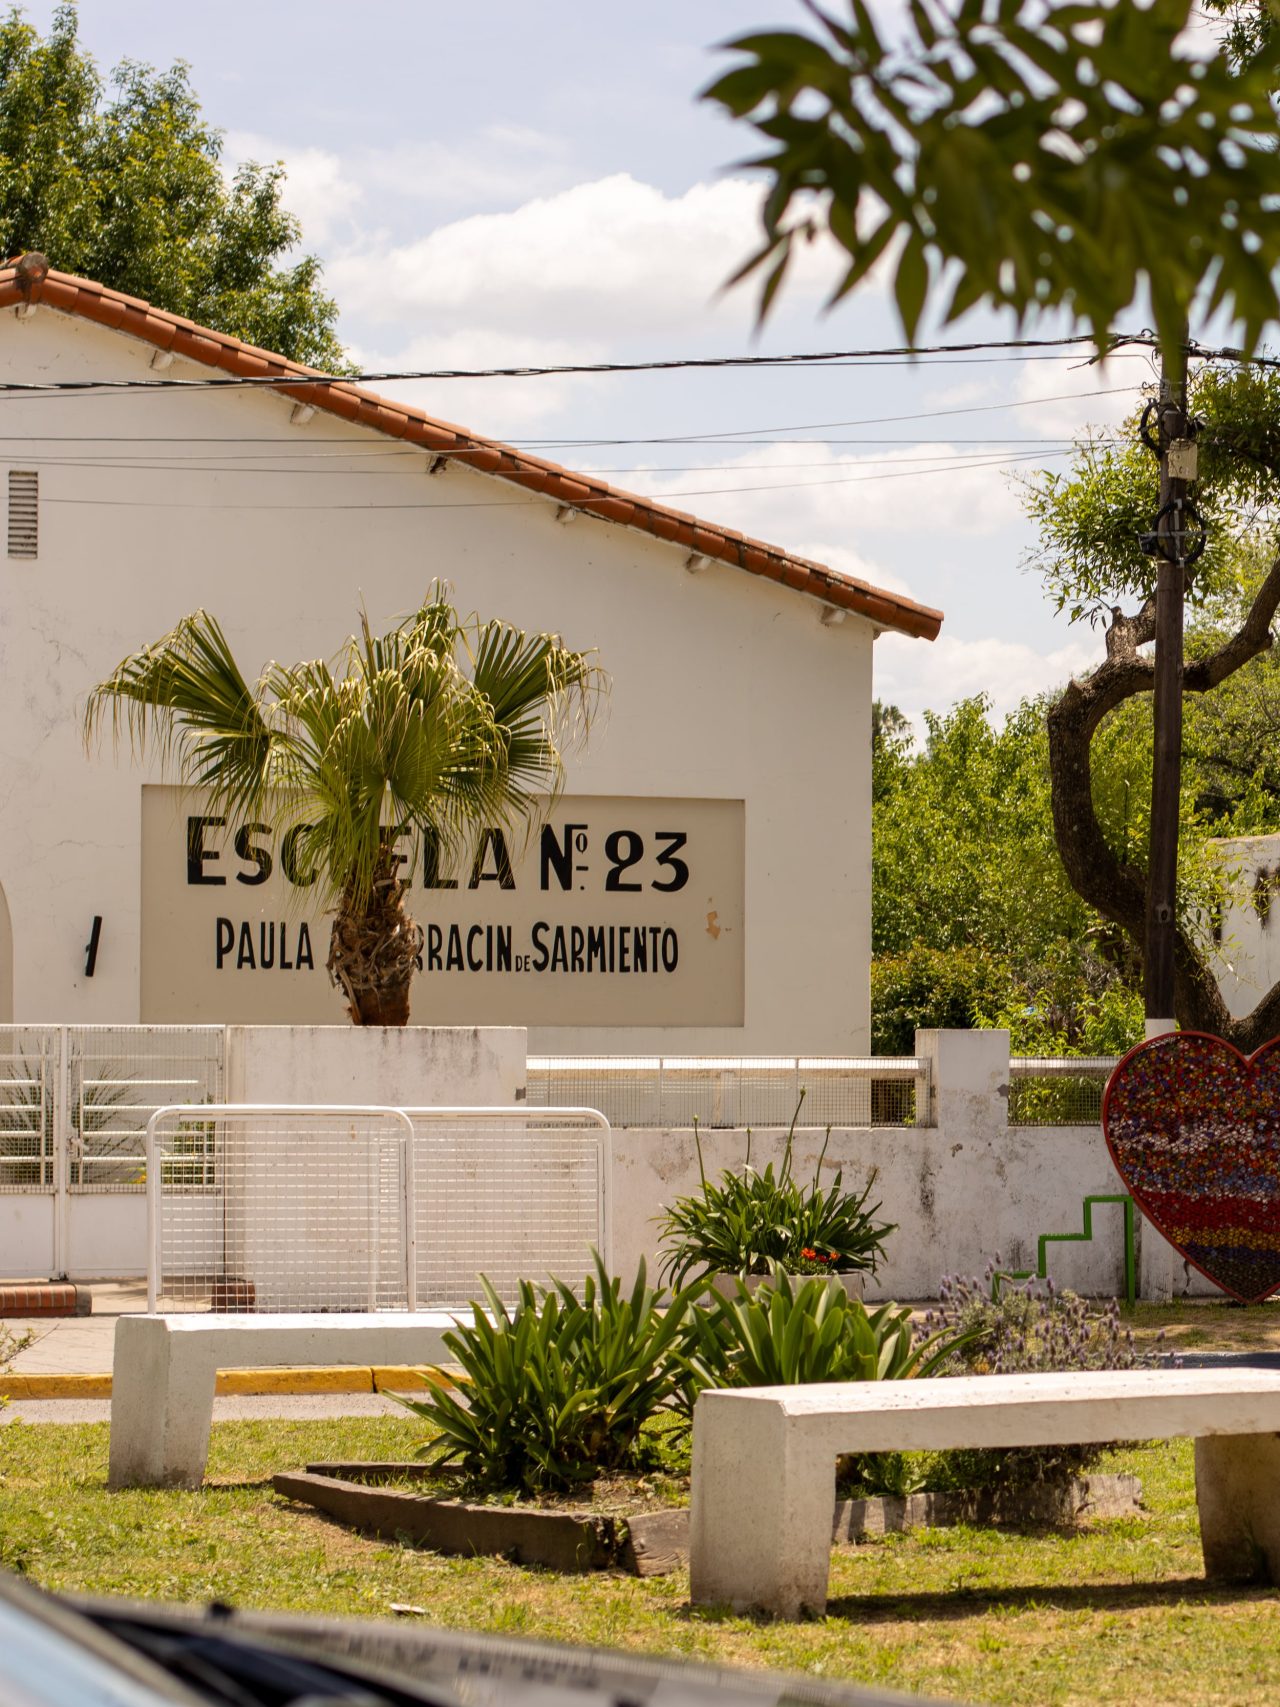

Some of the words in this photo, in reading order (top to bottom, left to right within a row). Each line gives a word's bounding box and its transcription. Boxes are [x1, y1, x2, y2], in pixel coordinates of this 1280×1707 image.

[187, 816, 516, 890] ESCELA
[604, 829, 690, 893] 23
[216, 917, 315, 970] PAULA
[515, 955, 531, 972] DE
[531, 921, 679, 973] SARMIENTO
